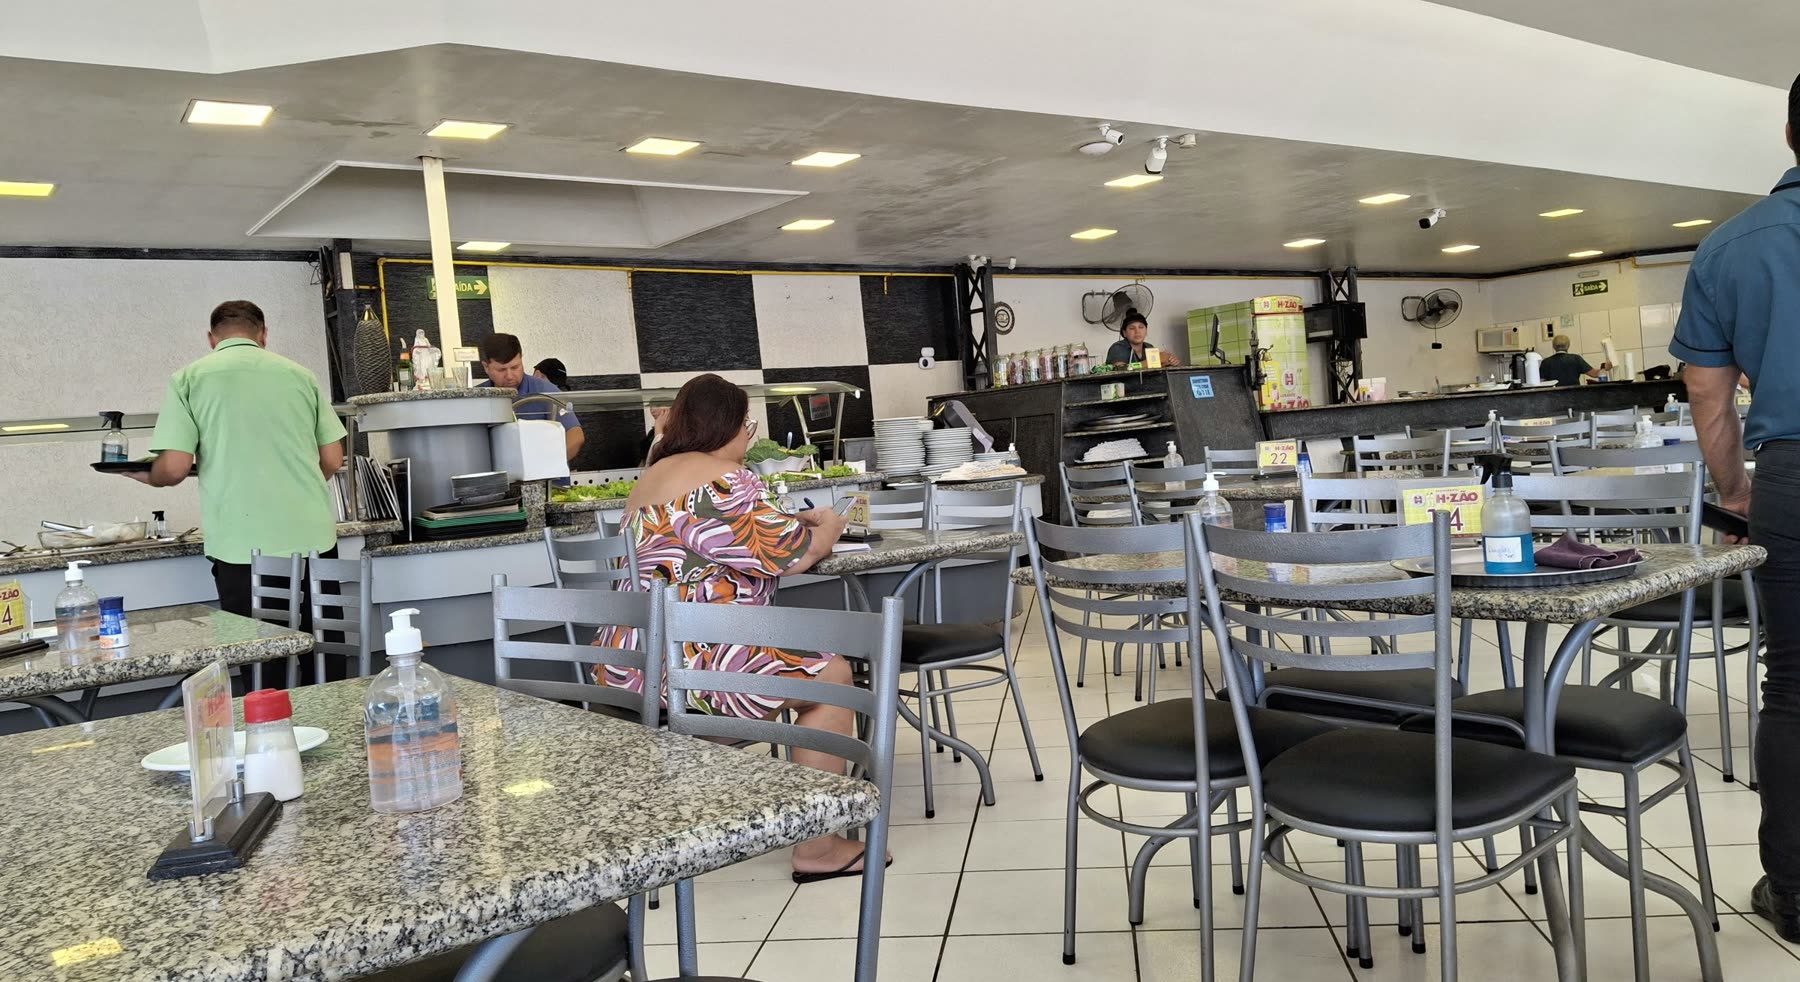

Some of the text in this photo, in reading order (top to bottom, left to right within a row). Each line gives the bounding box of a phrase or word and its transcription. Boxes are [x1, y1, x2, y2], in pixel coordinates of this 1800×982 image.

[454, 281, 473, 291] AÍDA
[1271, 452, 1287, 464] 22
[852, 506, 863, 522] 23
